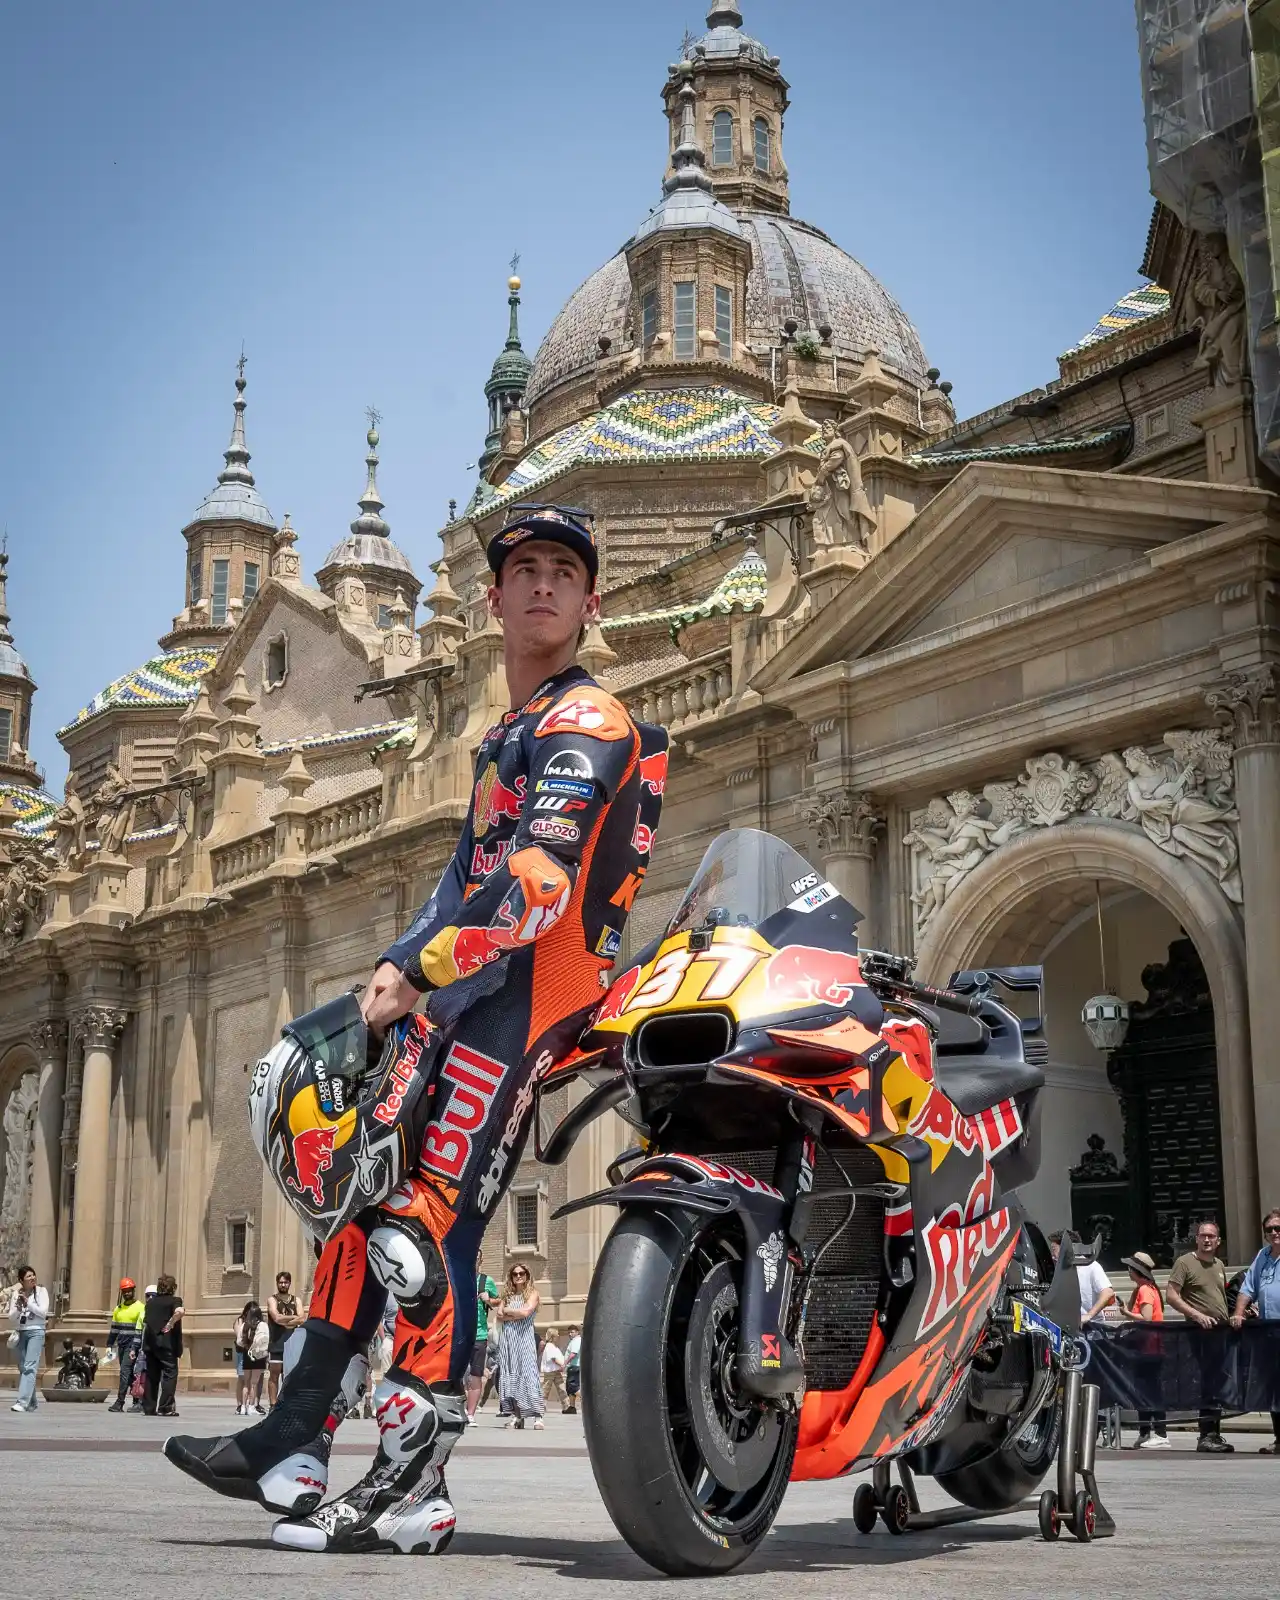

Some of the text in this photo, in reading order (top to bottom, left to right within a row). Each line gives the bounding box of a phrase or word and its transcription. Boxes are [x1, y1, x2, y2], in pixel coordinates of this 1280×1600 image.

[548, 766, 587, 779] MAN
[549, 782, 589, 794] MICHELIN
[533, 795, 589, 814] WP
[790, 871, 819, 896] WRS
[621, 941, 773, 1016] 37
[331, 1077, 345, 1113] CORNY
[372, 1071, 410, 1127] Red
[419, 1040, 510, 1182] Bull
